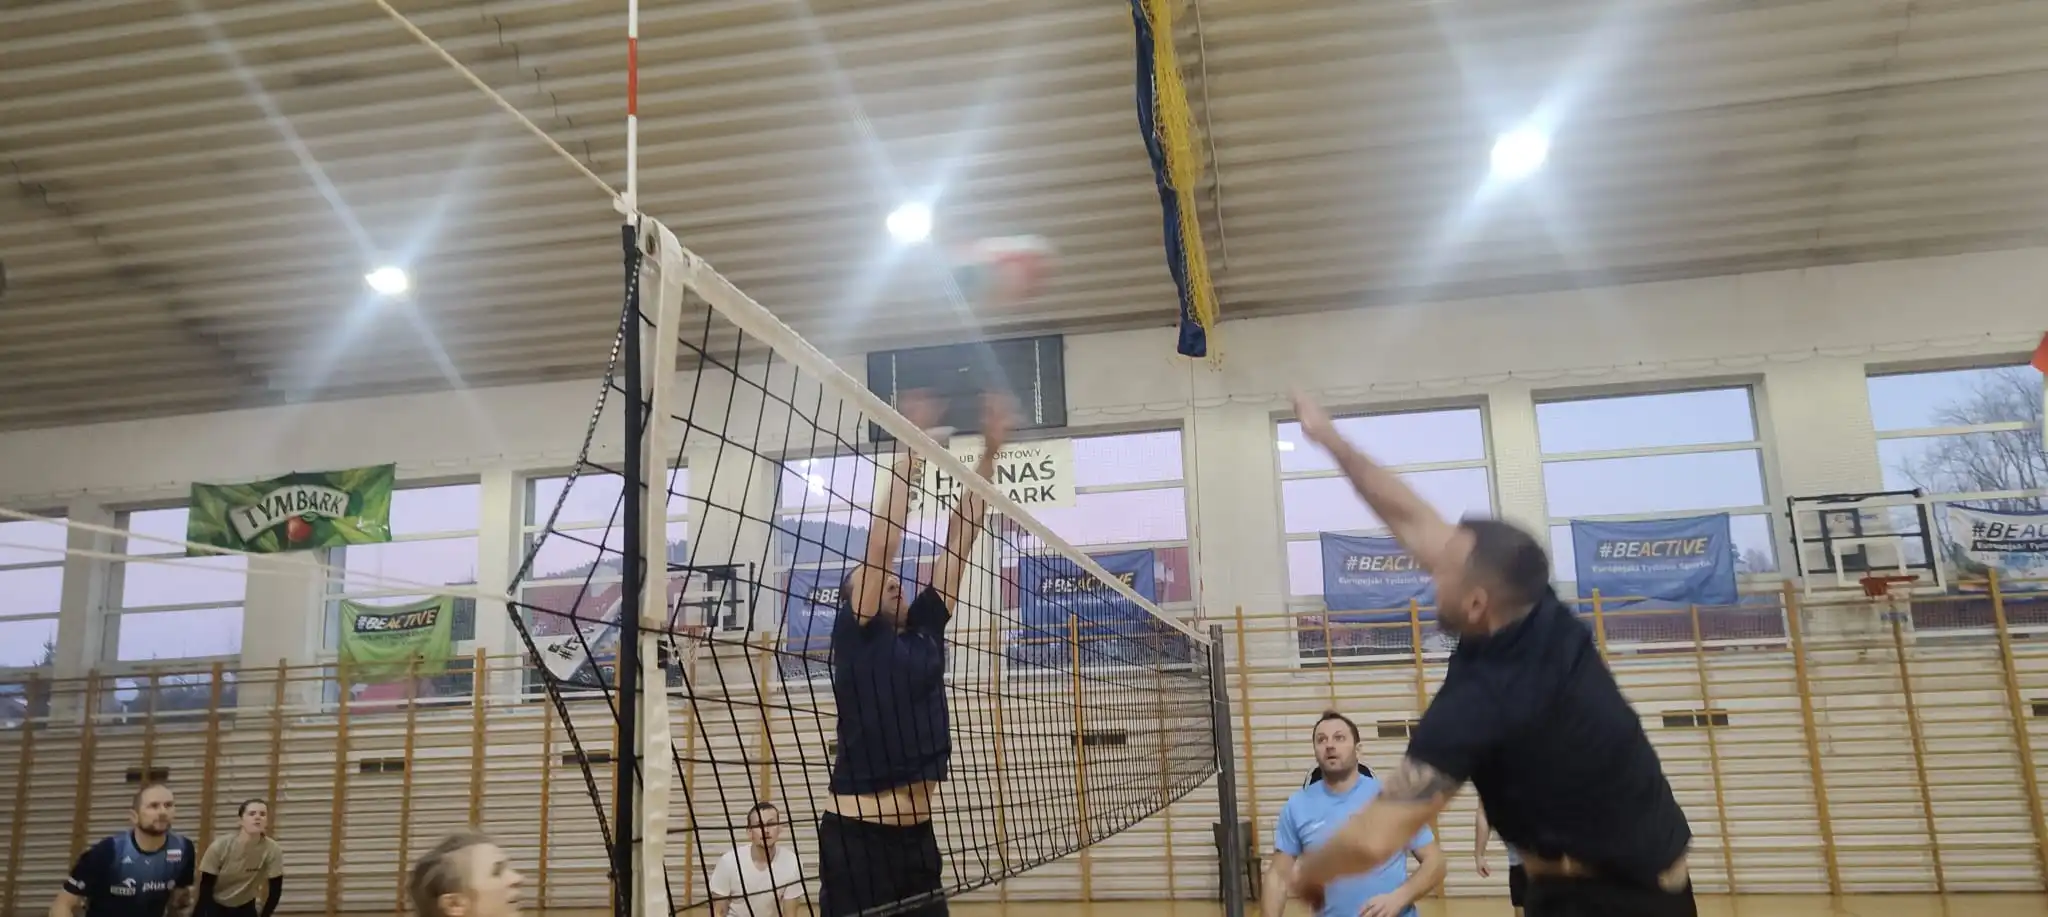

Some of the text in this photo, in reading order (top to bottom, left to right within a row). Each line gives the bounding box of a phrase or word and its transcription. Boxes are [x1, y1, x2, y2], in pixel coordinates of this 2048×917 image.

[978, 448, 1041, 462] SORTOWY
[936, 454, 1056, 489] HNAŚ
[937, 484, 1057, 510] TARK
[241, 490, 343, 529] TYMBARK
[1972, 522, 2048, 538] #BEAC
[1599, 537, 1708, 558] #BEACTIVE
[1346, 555, 1421, 571] #BEACT
[357, 609, 438, 630] #BEACTIVE
